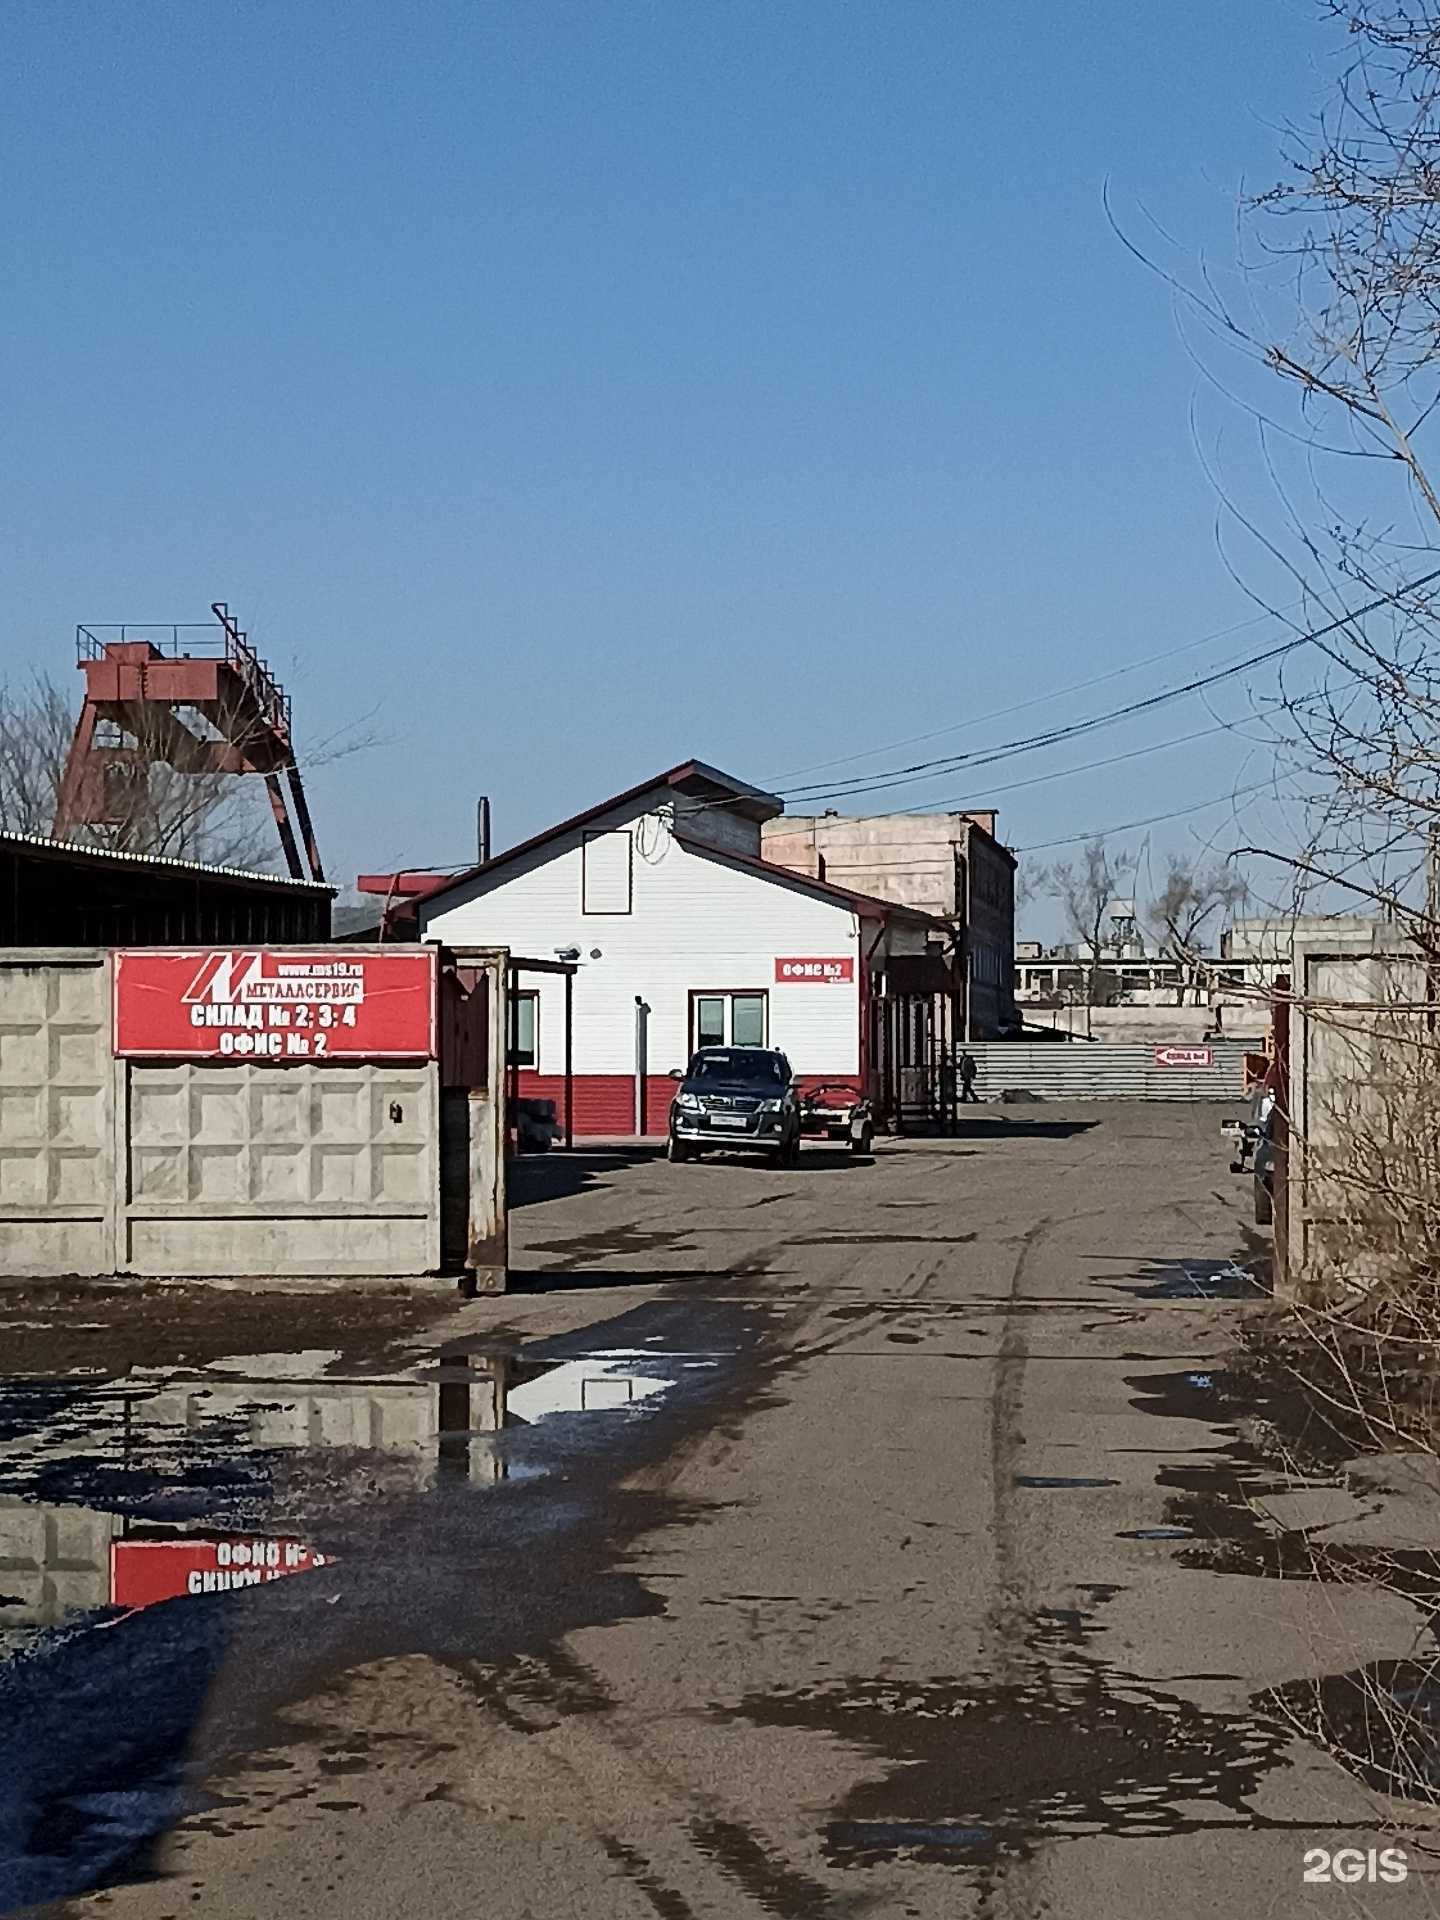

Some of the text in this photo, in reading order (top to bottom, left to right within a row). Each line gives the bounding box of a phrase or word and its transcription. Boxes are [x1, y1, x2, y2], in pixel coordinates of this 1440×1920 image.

[782, 963, 822, 976] ОФИС
[246, 982, 360, 999] МЕТАЛЛСЕРВИС
[190, 1004, 263, 1029] СКЛАД
[342, 1004, 356, 1027] 4
[219, 1032, 282, 1055] ОФИС
[313, 1032, 327, 1055] 2
